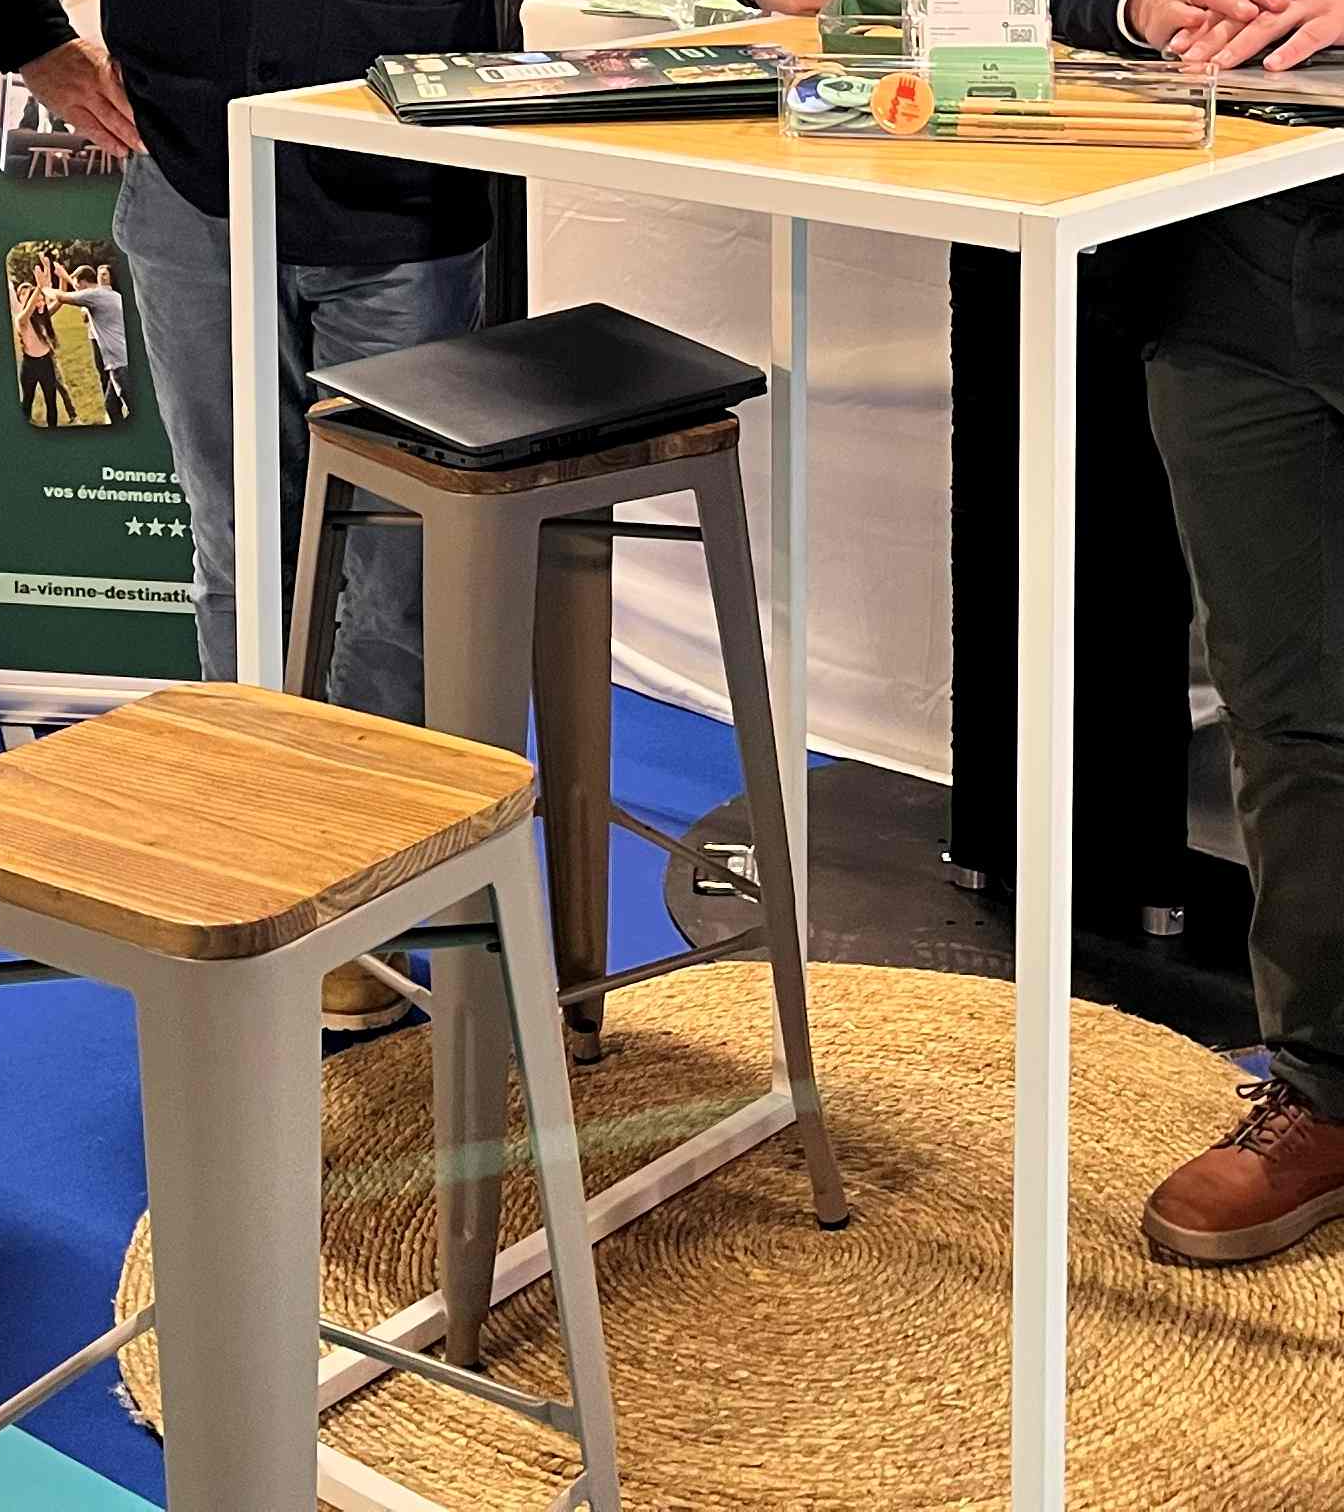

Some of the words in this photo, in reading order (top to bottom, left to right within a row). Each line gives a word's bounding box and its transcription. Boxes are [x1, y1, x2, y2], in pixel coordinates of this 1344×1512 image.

[102, 467, 167, 484] Donnez
[43, 487, 74, 499] vos
[78, 485, 182, 504] événements
